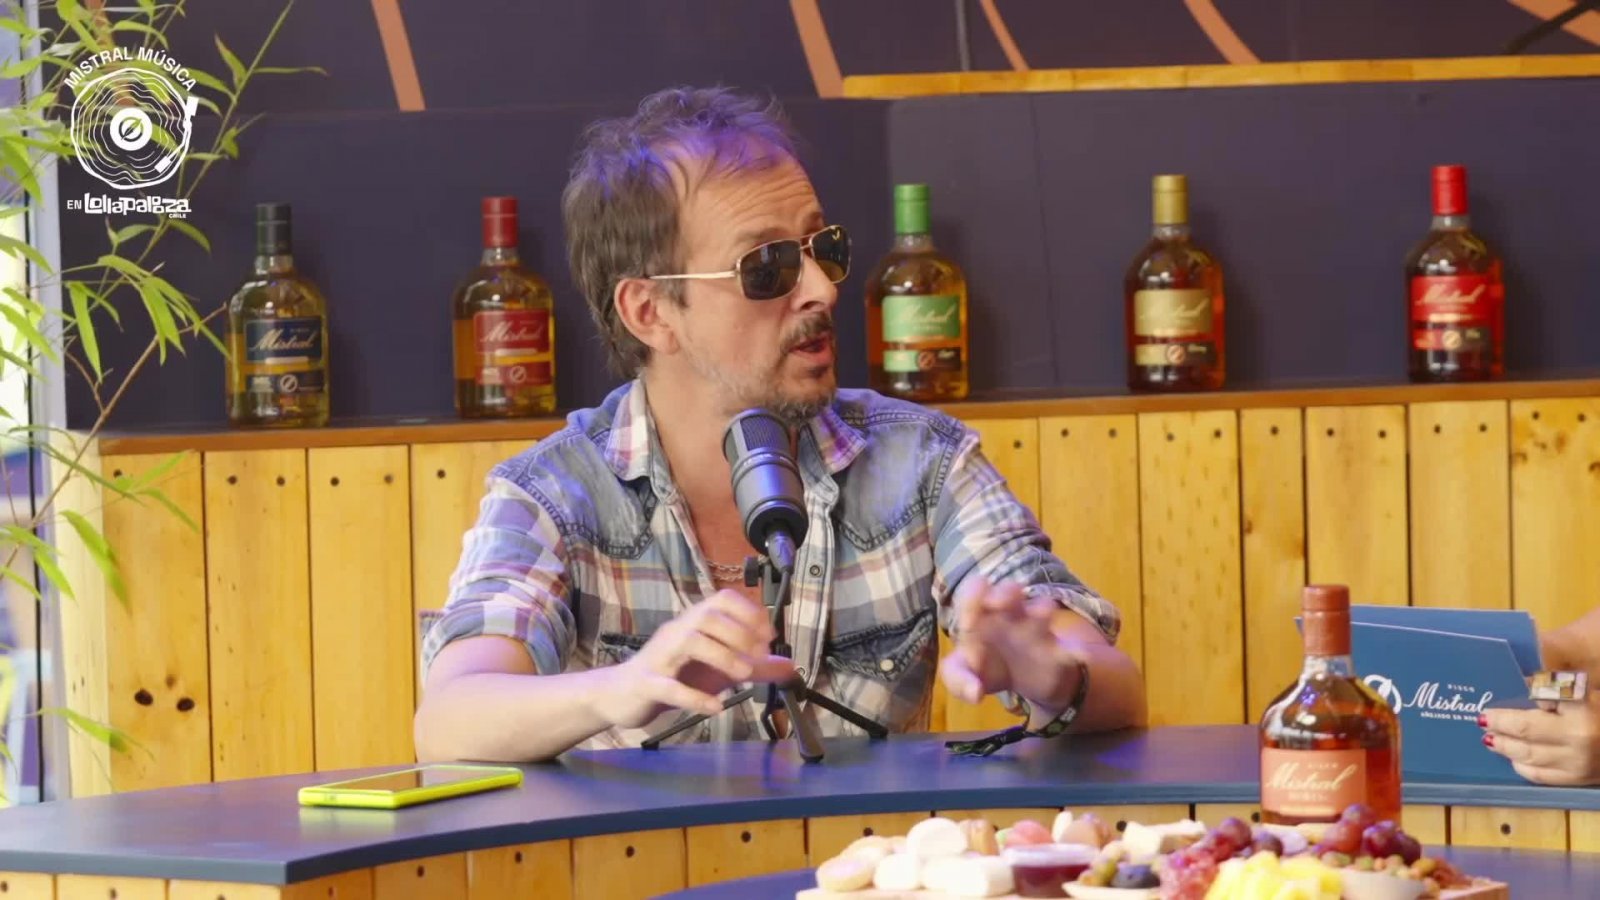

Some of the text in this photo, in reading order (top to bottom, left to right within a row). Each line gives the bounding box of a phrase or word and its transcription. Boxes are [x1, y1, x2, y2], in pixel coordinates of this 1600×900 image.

[248, 328, 318, 351] Mistral
[1403, 681, 1493, 713] Mistral
[1265, 761, 1358, 790] Mistral
